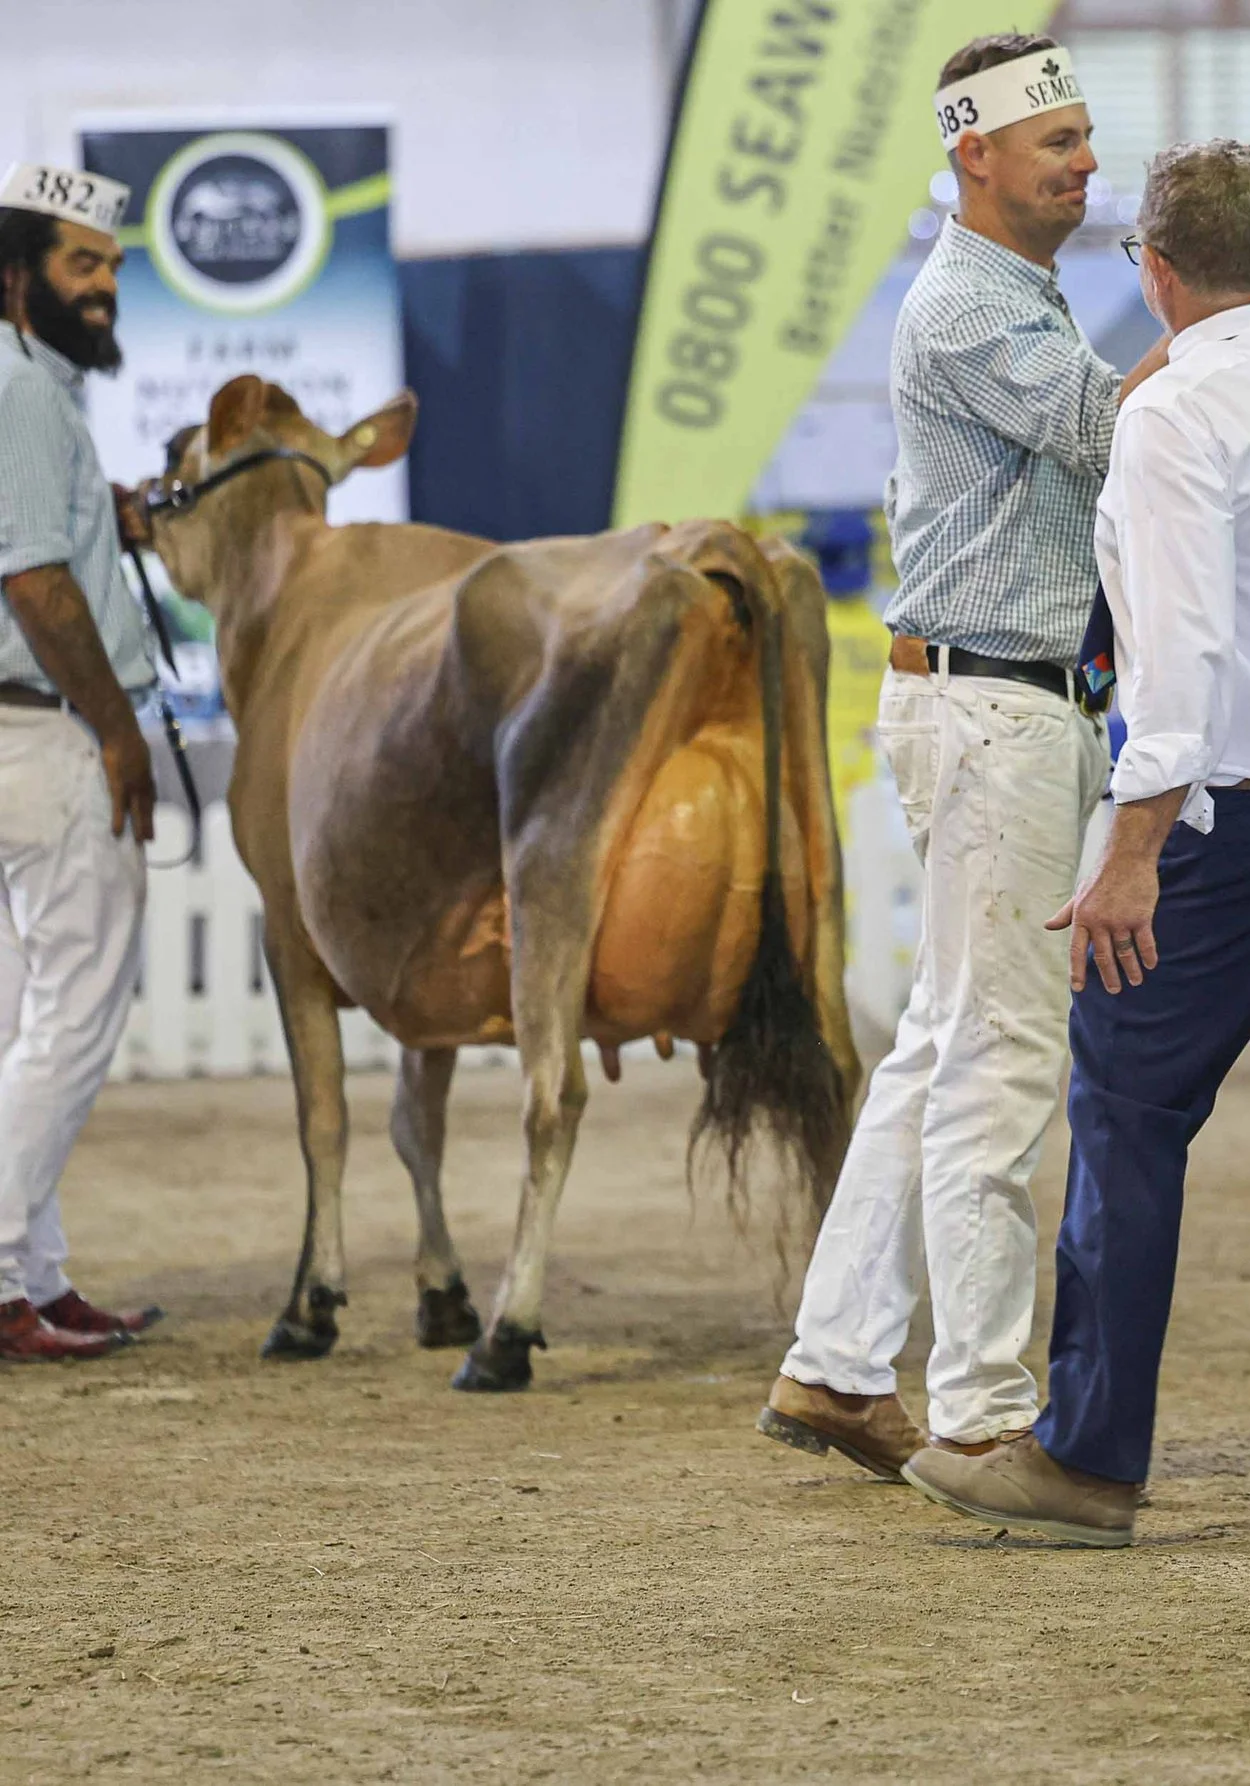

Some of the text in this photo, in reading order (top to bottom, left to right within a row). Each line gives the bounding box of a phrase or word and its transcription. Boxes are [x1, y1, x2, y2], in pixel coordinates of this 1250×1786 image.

[24, 168, 94, 212] 382
[658, 233, 765, 429] 0800
[780, 193, 863, 355] Better
